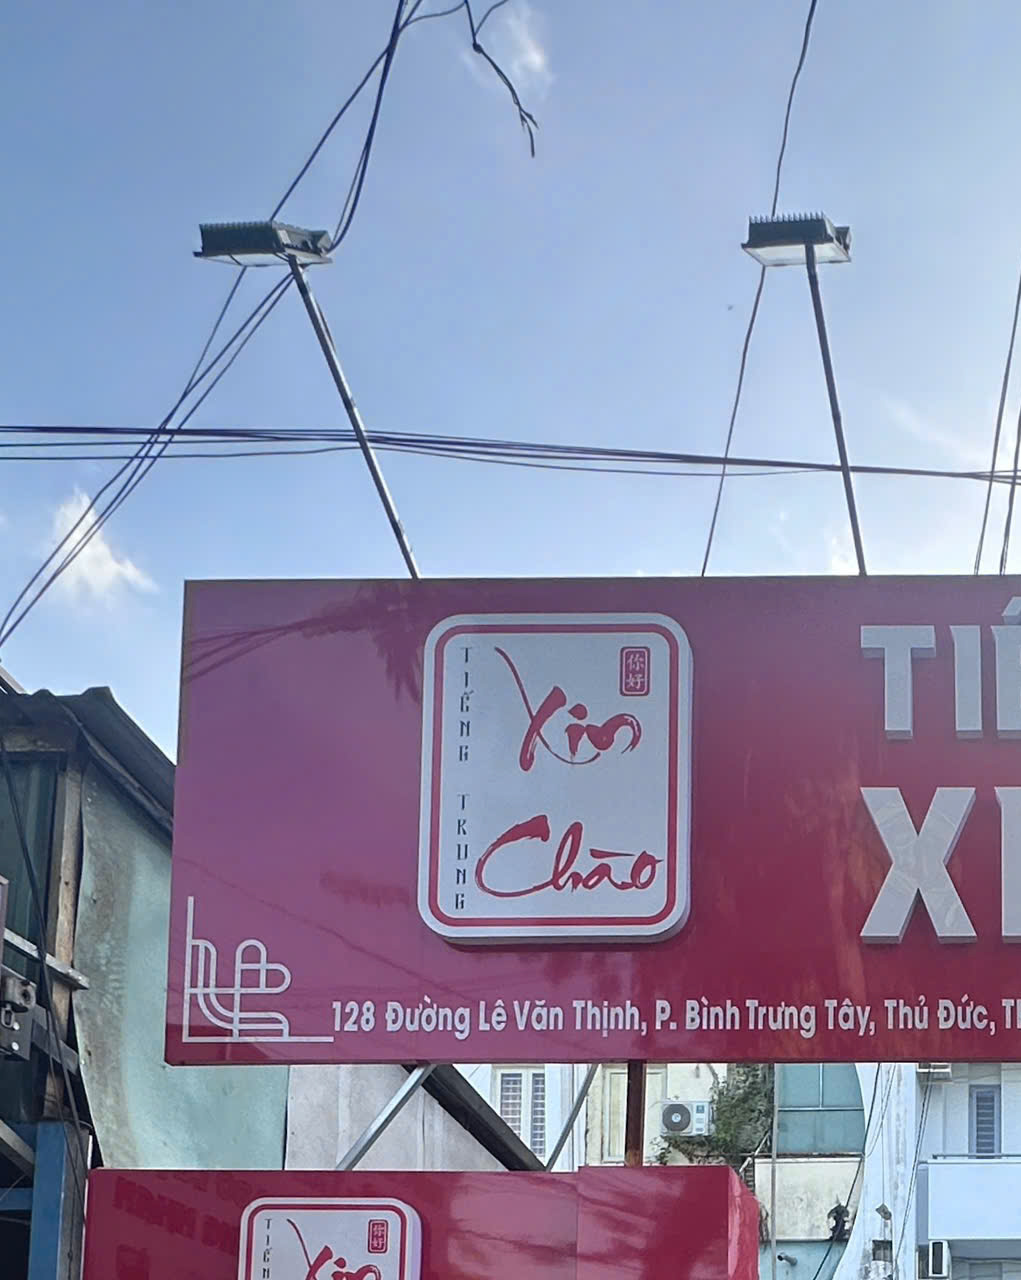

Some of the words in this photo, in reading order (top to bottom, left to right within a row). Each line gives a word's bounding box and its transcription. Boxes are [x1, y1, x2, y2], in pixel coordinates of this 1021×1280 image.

[626, 653, 646, 690] 你好
[494, 646, 642, 771] Xin
[332, 1000, 376, 1031] 128
[386, 995, 471, 1040] Đường
[479, 999, 507, 1031] Lê
[513, 1000, 563, 1031] Văn
[572, 1000, 647, 1037] Thịnh,
[655, 1000, 677, 1030] P.
[685, 996, 739, 1030] Bình
[746, 1000, 816, 1038] Trưng
[824, 999, 875, 1036] Tây,
[884, 995, 929, 1029] Thủ
[938, 994, 996, 1036] Đức,
